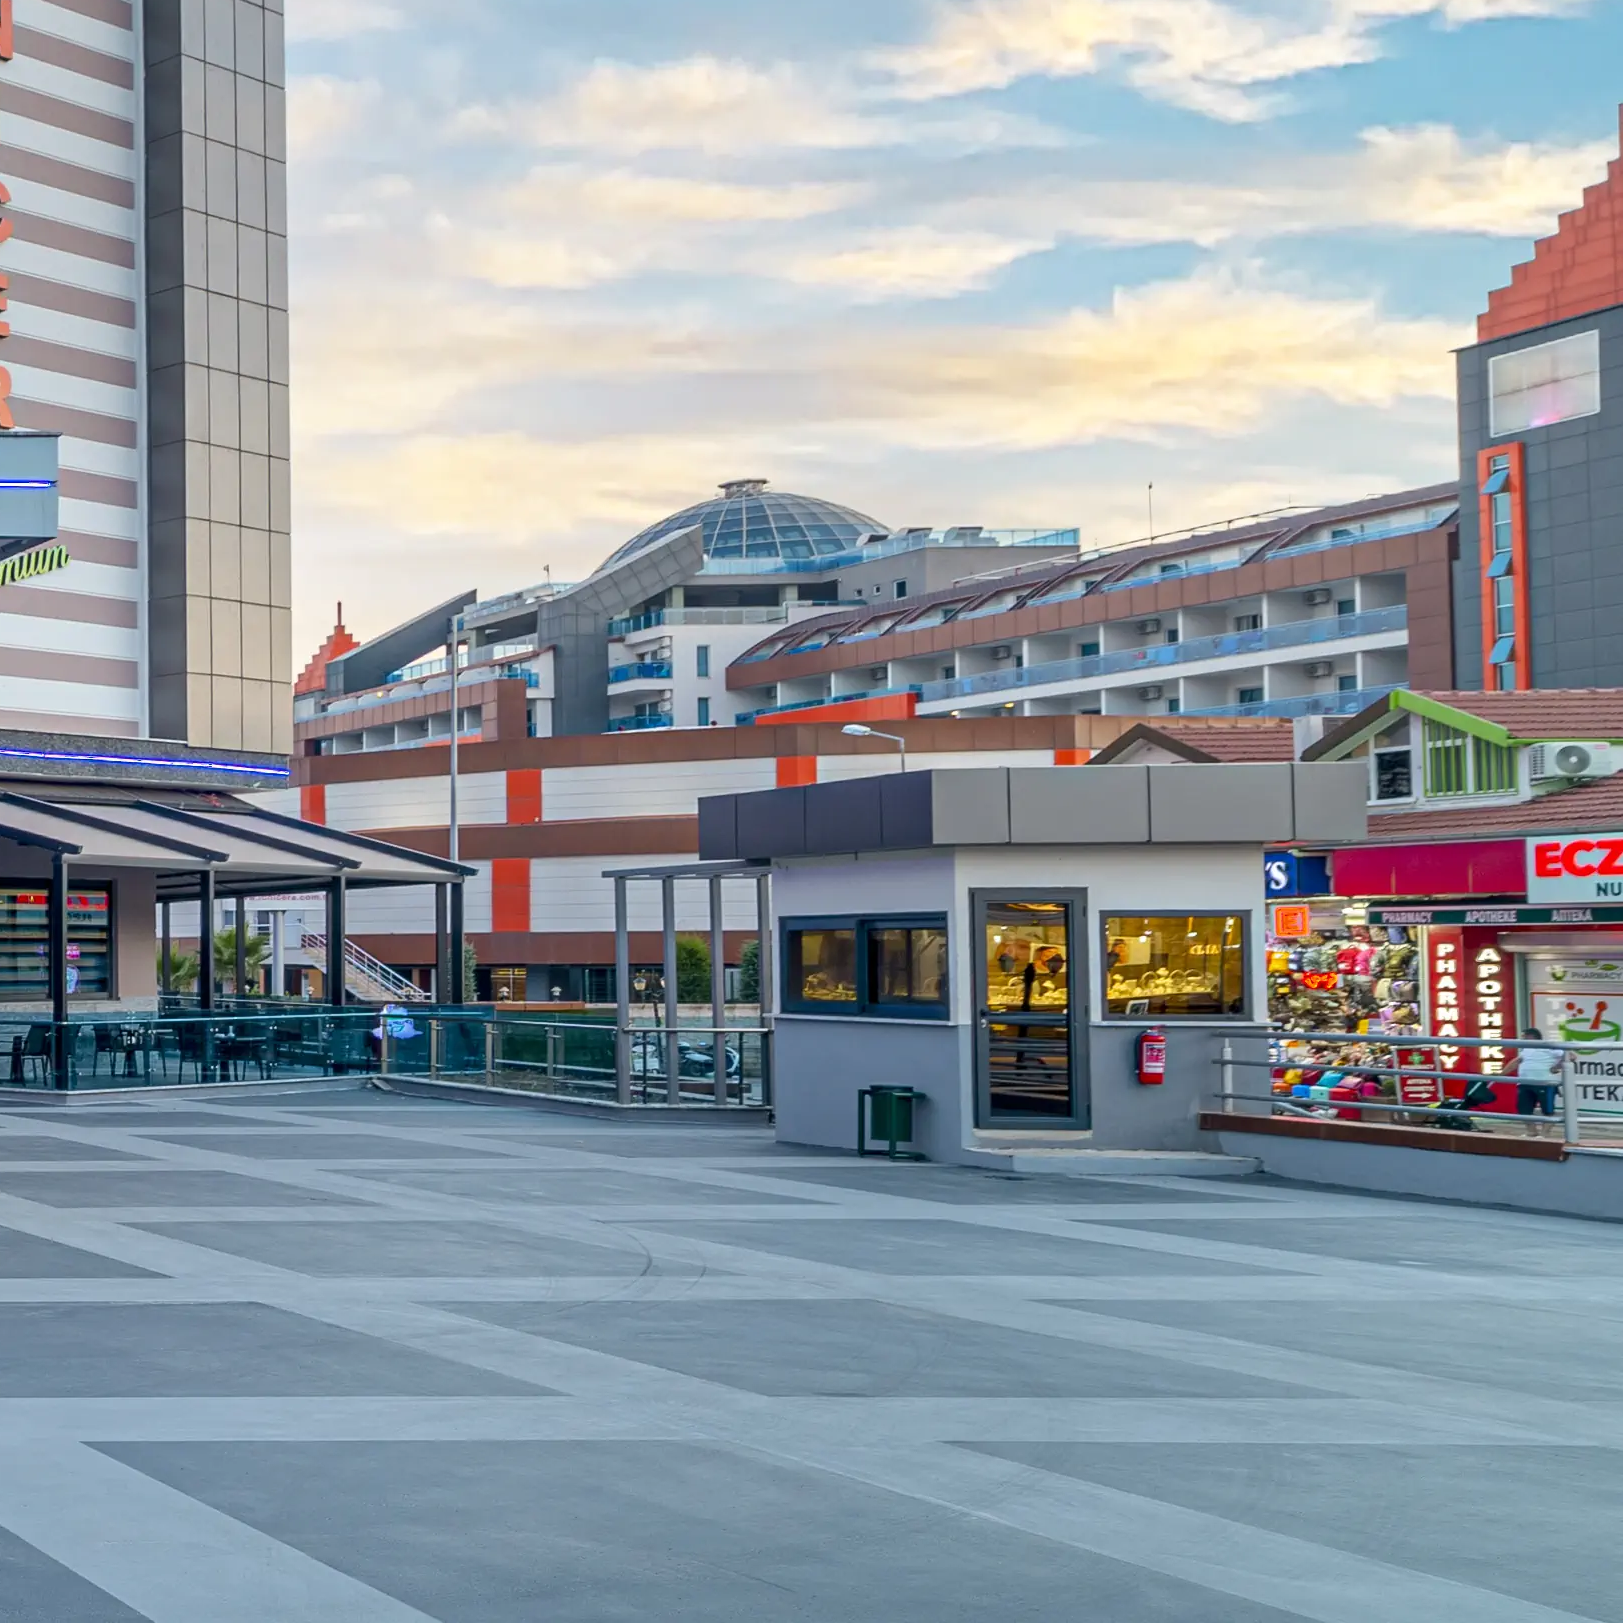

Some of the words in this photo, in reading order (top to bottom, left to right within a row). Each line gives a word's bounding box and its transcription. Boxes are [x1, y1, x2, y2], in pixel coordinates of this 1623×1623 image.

[1534, 839, 1623, 878] ECZ
[1382, 911, 1432, 923] PHARMACY
[1465, 909, 1517, 923] APOTHEKE
[1436, 943, 1459, 1069] PHARMACY
[1475, 948, 1505, 1075] APOTHEKE
